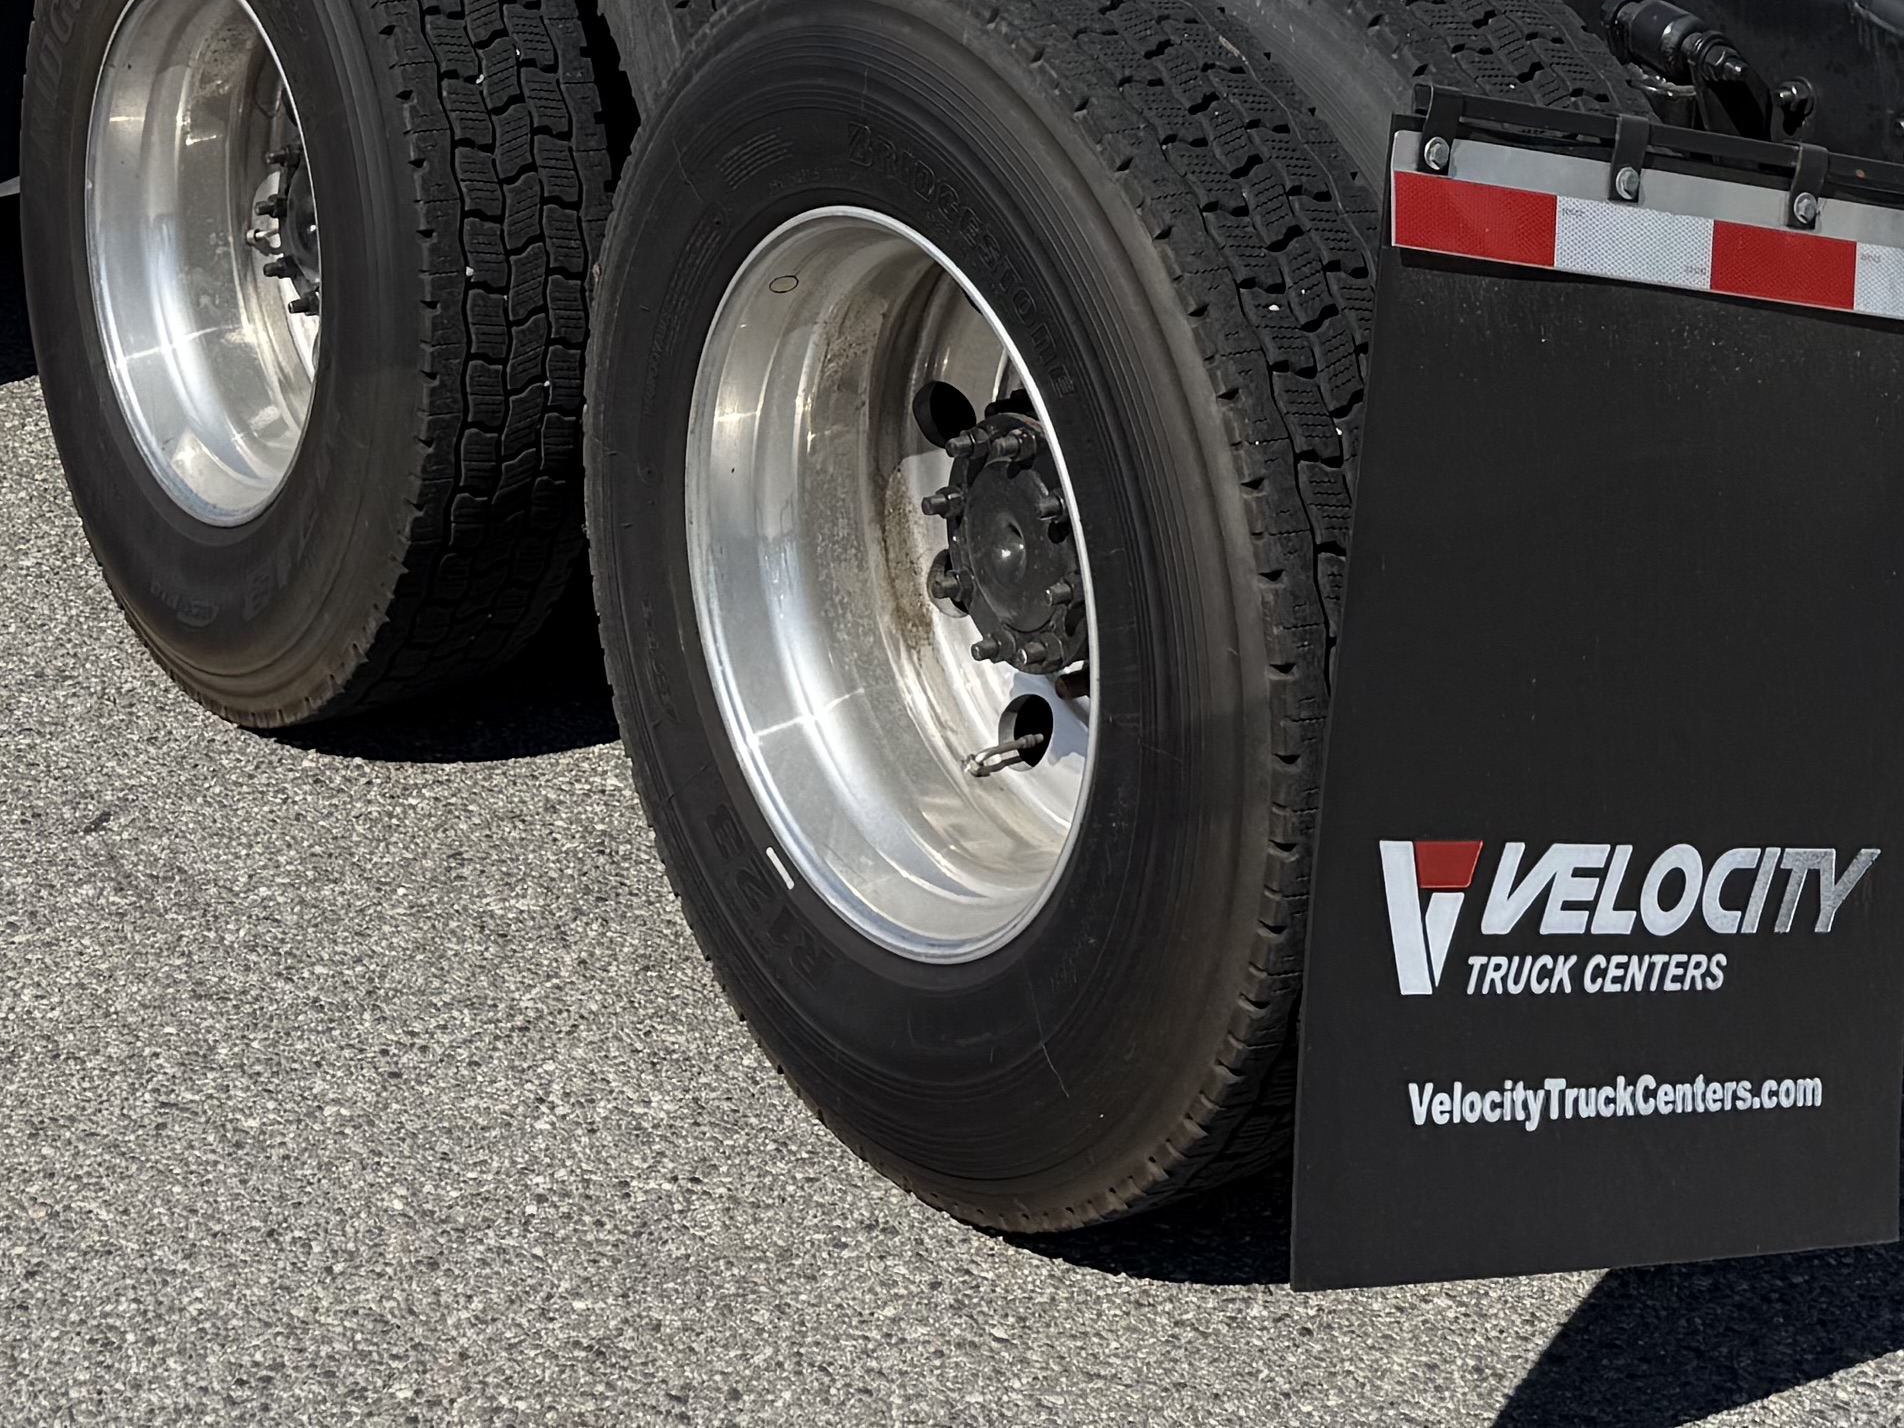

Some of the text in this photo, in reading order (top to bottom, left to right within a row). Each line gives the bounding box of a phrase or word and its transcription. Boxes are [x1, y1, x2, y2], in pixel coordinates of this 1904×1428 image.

[1480, 841, 1882, 936] VELOCITY
[1466, 953, 1728, 995] TRUCK CENTERS
[1408, 1073, 1824, 1132] VelocityTruckCenters.com
